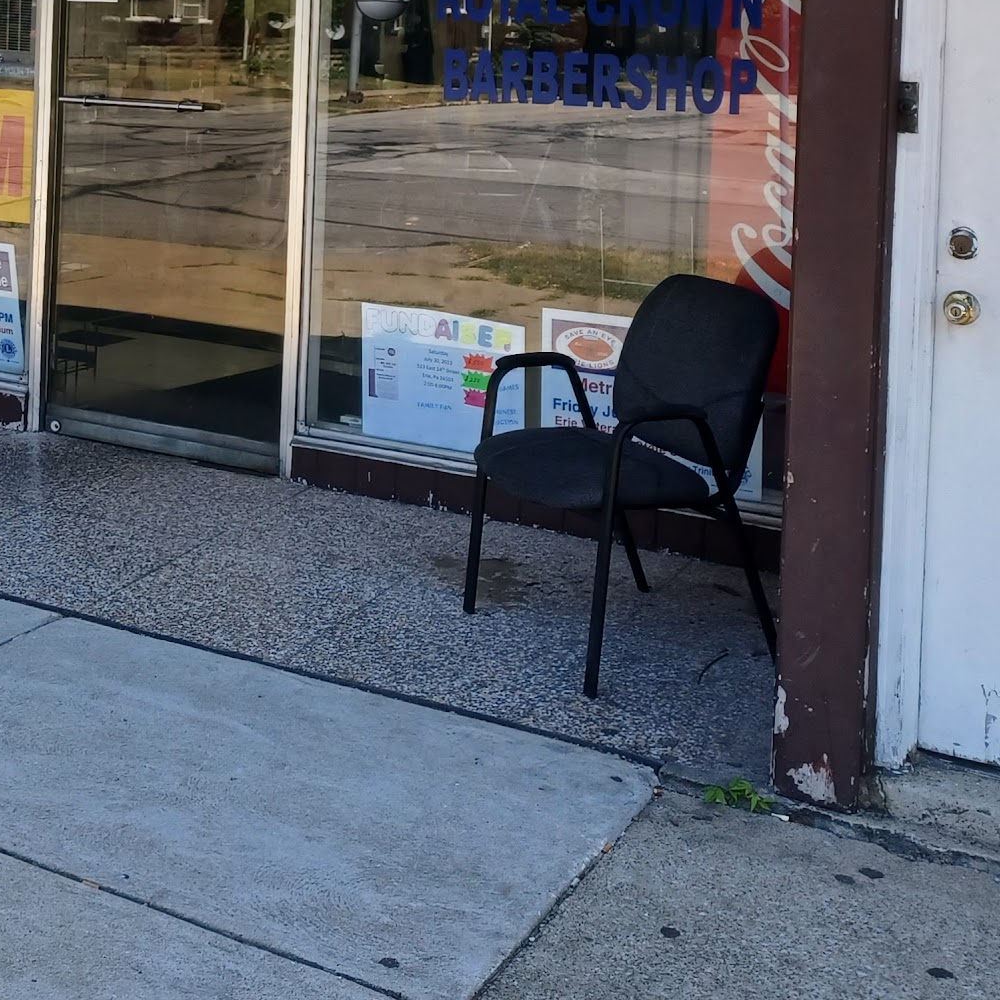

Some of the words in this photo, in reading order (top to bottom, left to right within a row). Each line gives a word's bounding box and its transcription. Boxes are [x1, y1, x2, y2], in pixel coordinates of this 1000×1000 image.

[443, 48, 758, 115] BARBERSHOP
[564, 329, 584, 340] SAVE
[429, 349, 449, 357] Saturday
[588, 360, 615, 369] LIONS
[582, 378, 612, 395] etr
[553, 398, 598, 416] Fridy
[555, 415, 577, 428] Erie
[692, 465, 712, 476] Trini
